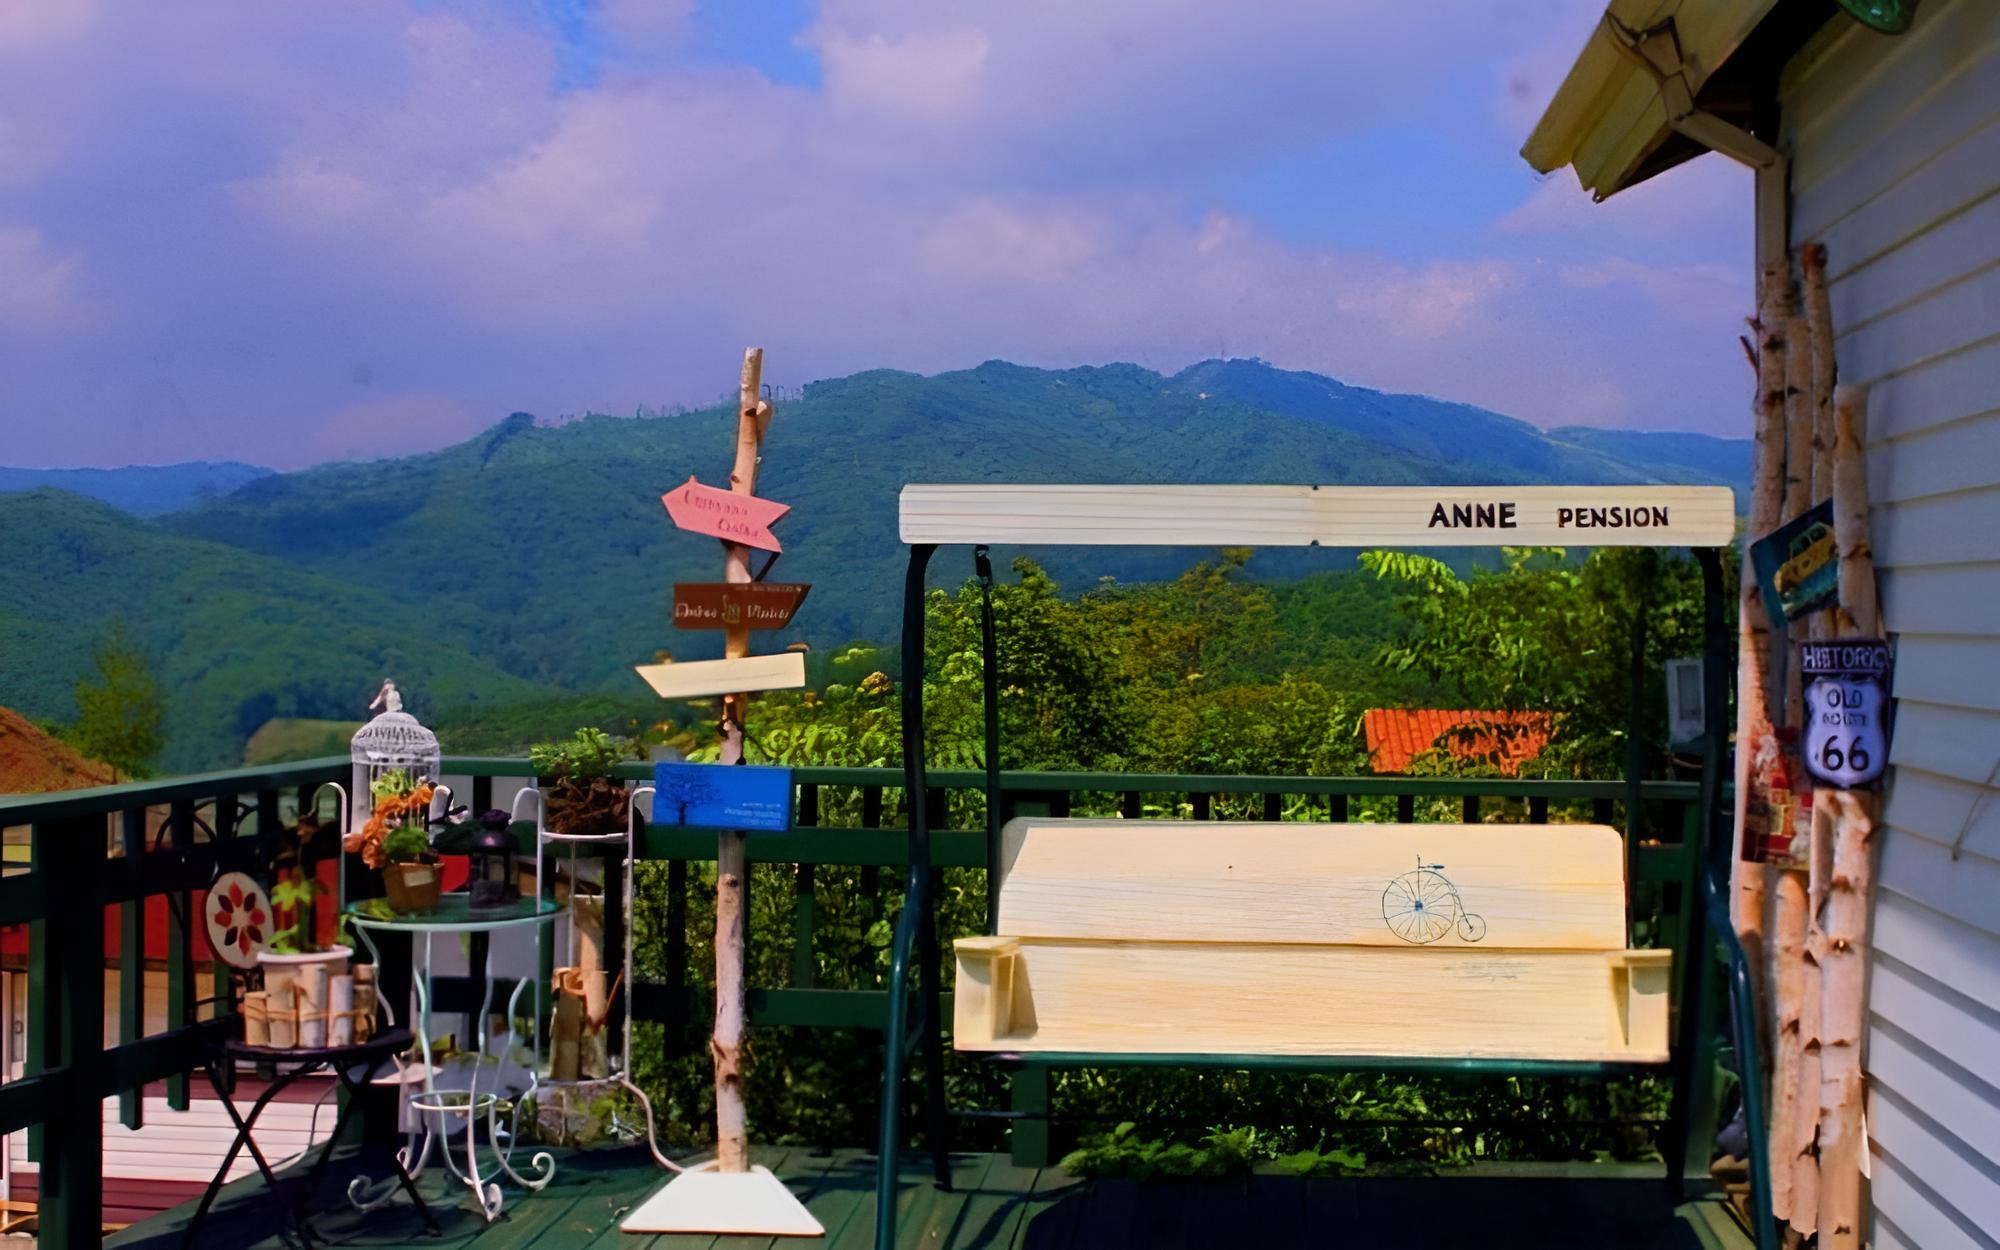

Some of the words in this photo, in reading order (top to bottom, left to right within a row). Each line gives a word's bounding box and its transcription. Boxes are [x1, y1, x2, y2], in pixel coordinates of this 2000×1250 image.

[1428, 502, 1517, 528] ANNE
[1558, 506, 1669, 528] PENSION
[1827, 688, 1863, 709] OLD
[1822, 735, 1870, 771] 66
